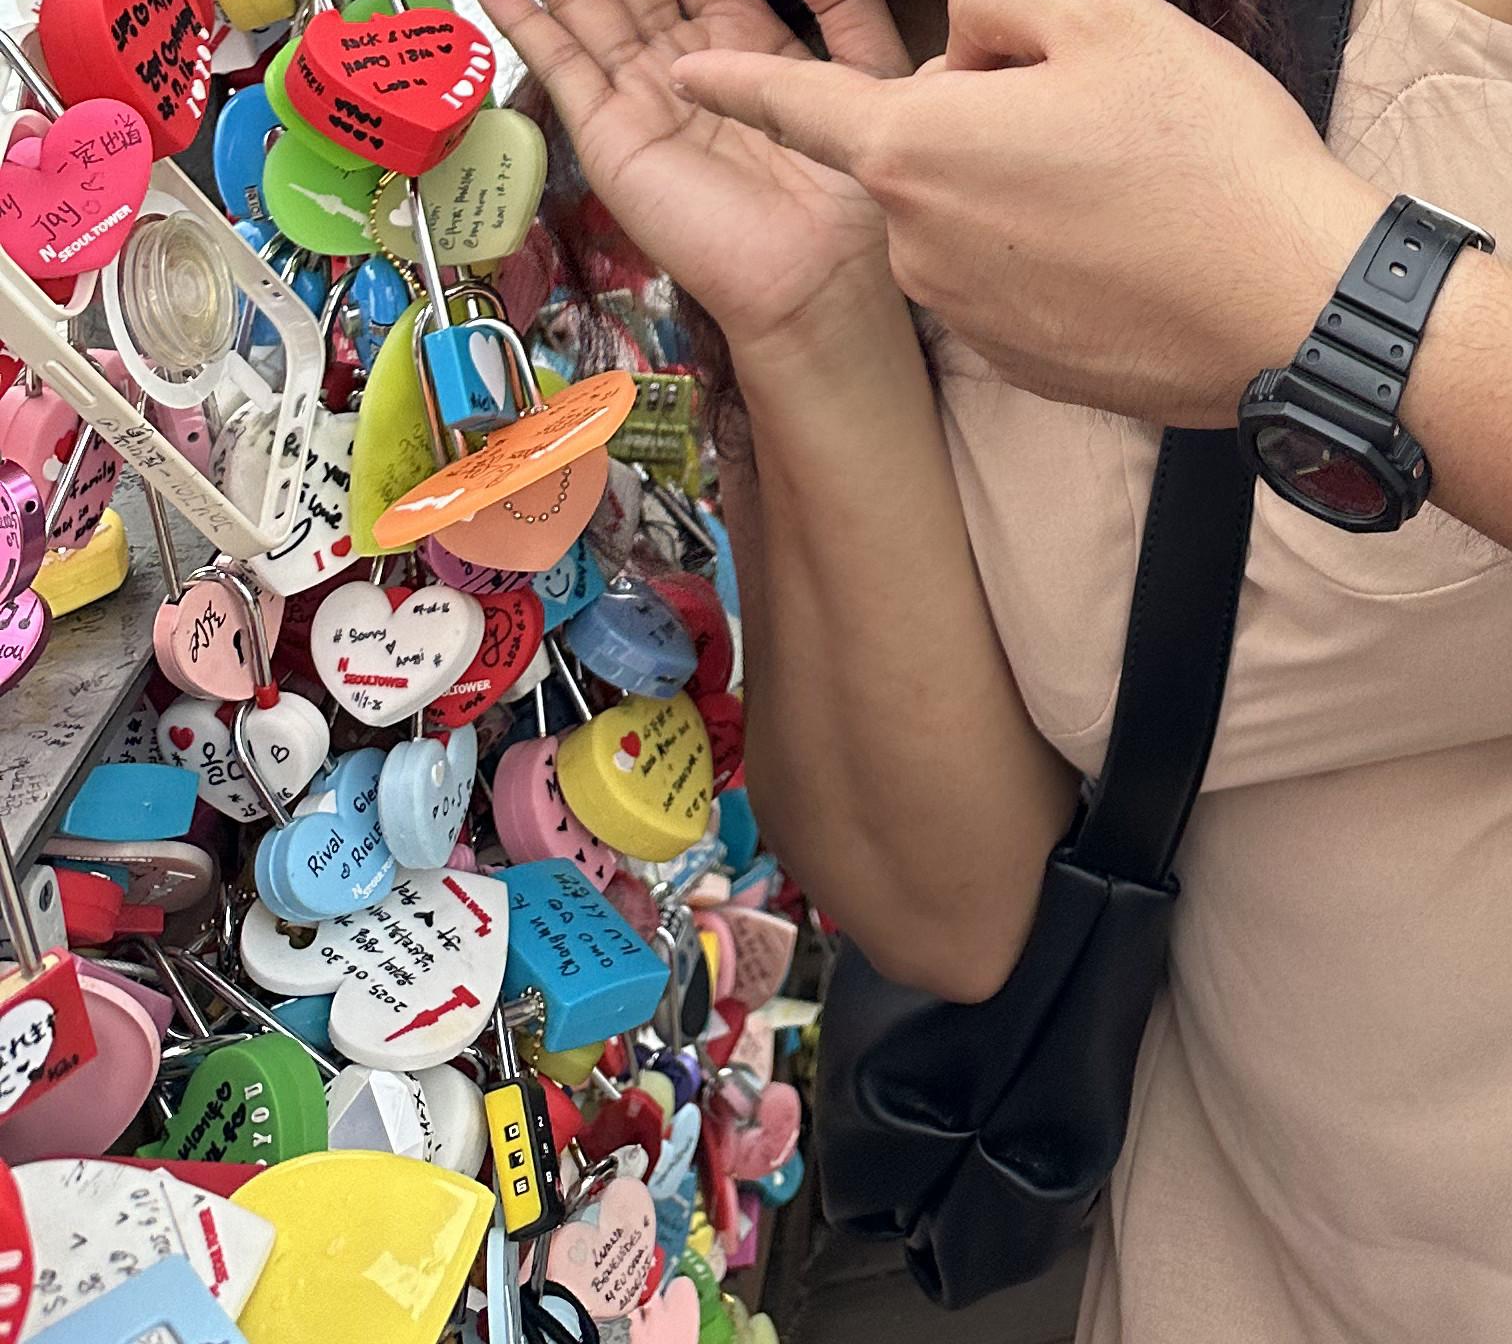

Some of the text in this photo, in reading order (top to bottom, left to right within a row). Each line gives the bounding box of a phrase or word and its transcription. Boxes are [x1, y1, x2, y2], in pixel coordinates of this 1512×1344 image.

[464, 41, 493, 84] YOU
[38, 244, 58, 263] N
[307, 828, 345, 879] Rival
[351, 820, 384, 868] RIGLE
[244, 1082, 273, 1148] YOU
[508, 1124, 520, 1138] 0
